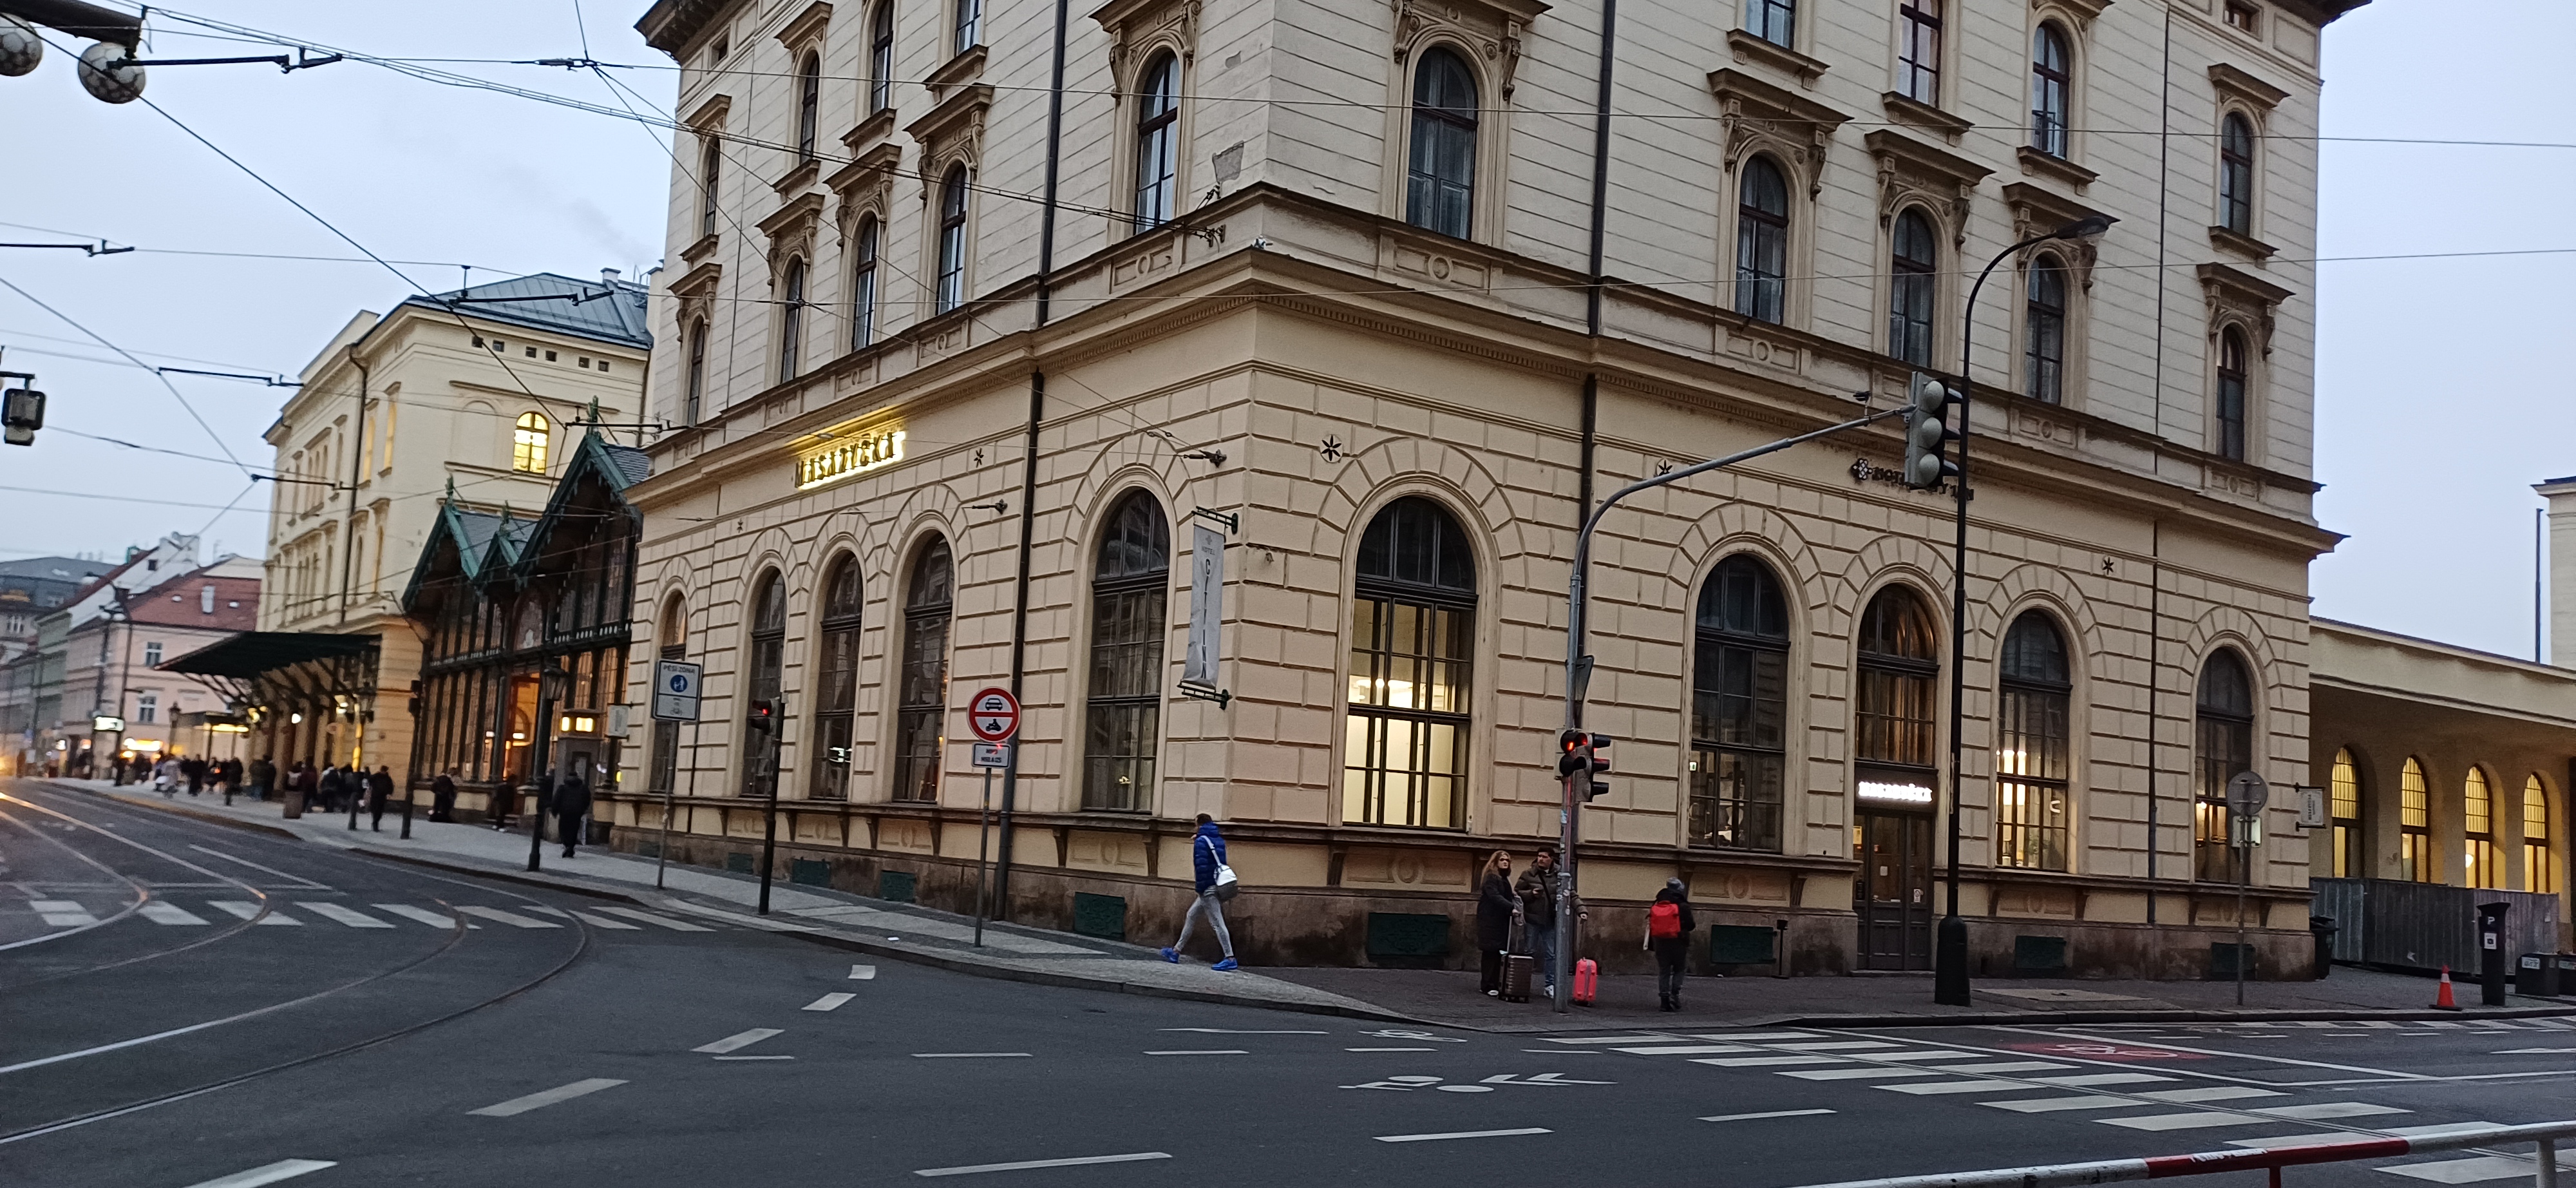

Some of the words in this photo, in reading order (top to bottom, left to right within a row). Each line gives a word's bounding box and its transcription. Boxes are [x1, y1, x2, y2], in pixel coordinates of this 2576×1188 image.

[795, 432, 897, 488] MASARYČKA
[1201, 546, 1216, 555] HOTEL
[2487, 916, 2496, 925] P
